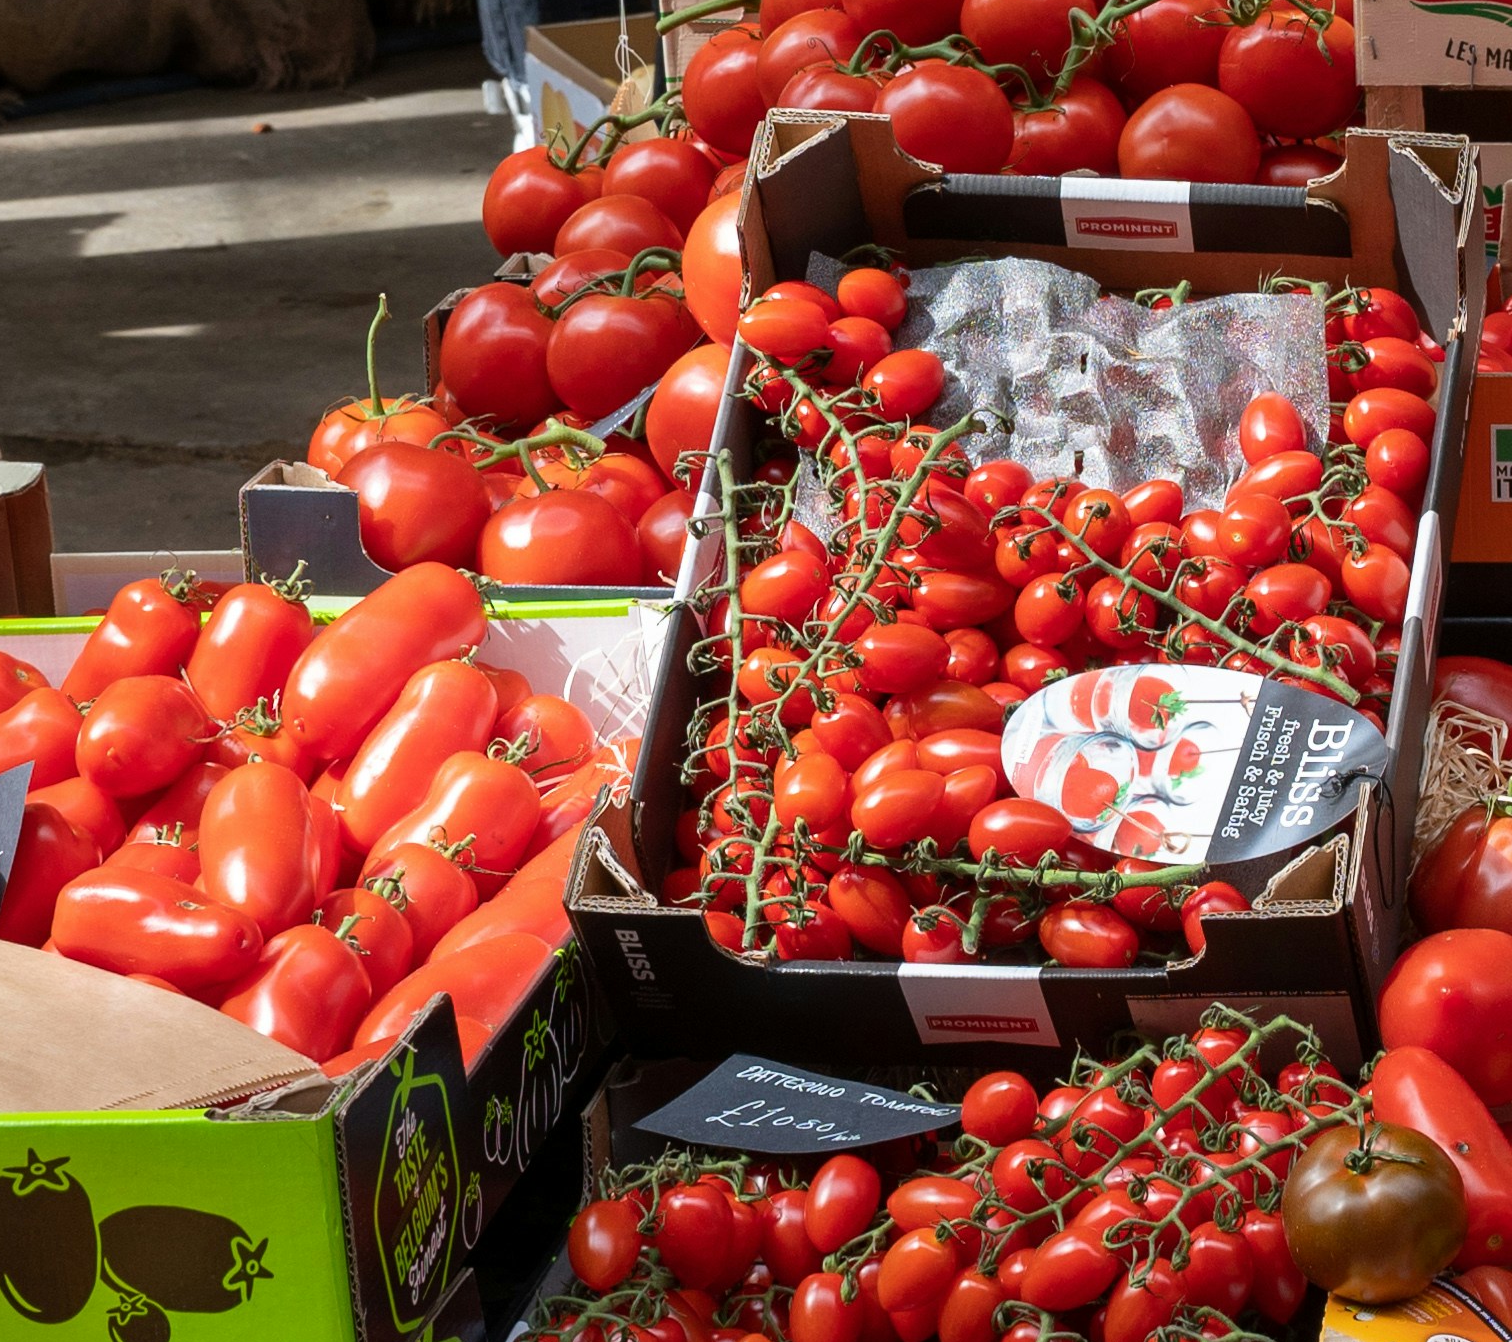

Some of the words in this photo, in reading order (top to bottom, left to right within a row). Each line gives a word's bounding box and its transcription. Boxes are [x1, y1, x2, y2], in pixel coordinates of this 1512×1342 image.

[1444, 37, 1478, 69] LES
[1078, 220, 1176, 237] PROMINENT
[1249, 704, 1283, 764] Frisch
[1271, 719, 1300, 770] fresh
[1243, 764, 1263, 781] &
[1266, 770, 1285, 785] &
[1279, 718, 1354, 828] Bliss
[1221, 783, 1257, 840] Saftig
[1248, 786, 1278, 827] juicy
[614, 929, 655, 980] BLISS
[929, 1019, 1034, 1031] PROMINENT
[736, 1066, 846, 1098] DATTERINO
[396, 1107, 417, 1158] The
[393, 1120, 429, 1207] TASTE
[408, 1197, 448, 1306] Finest
